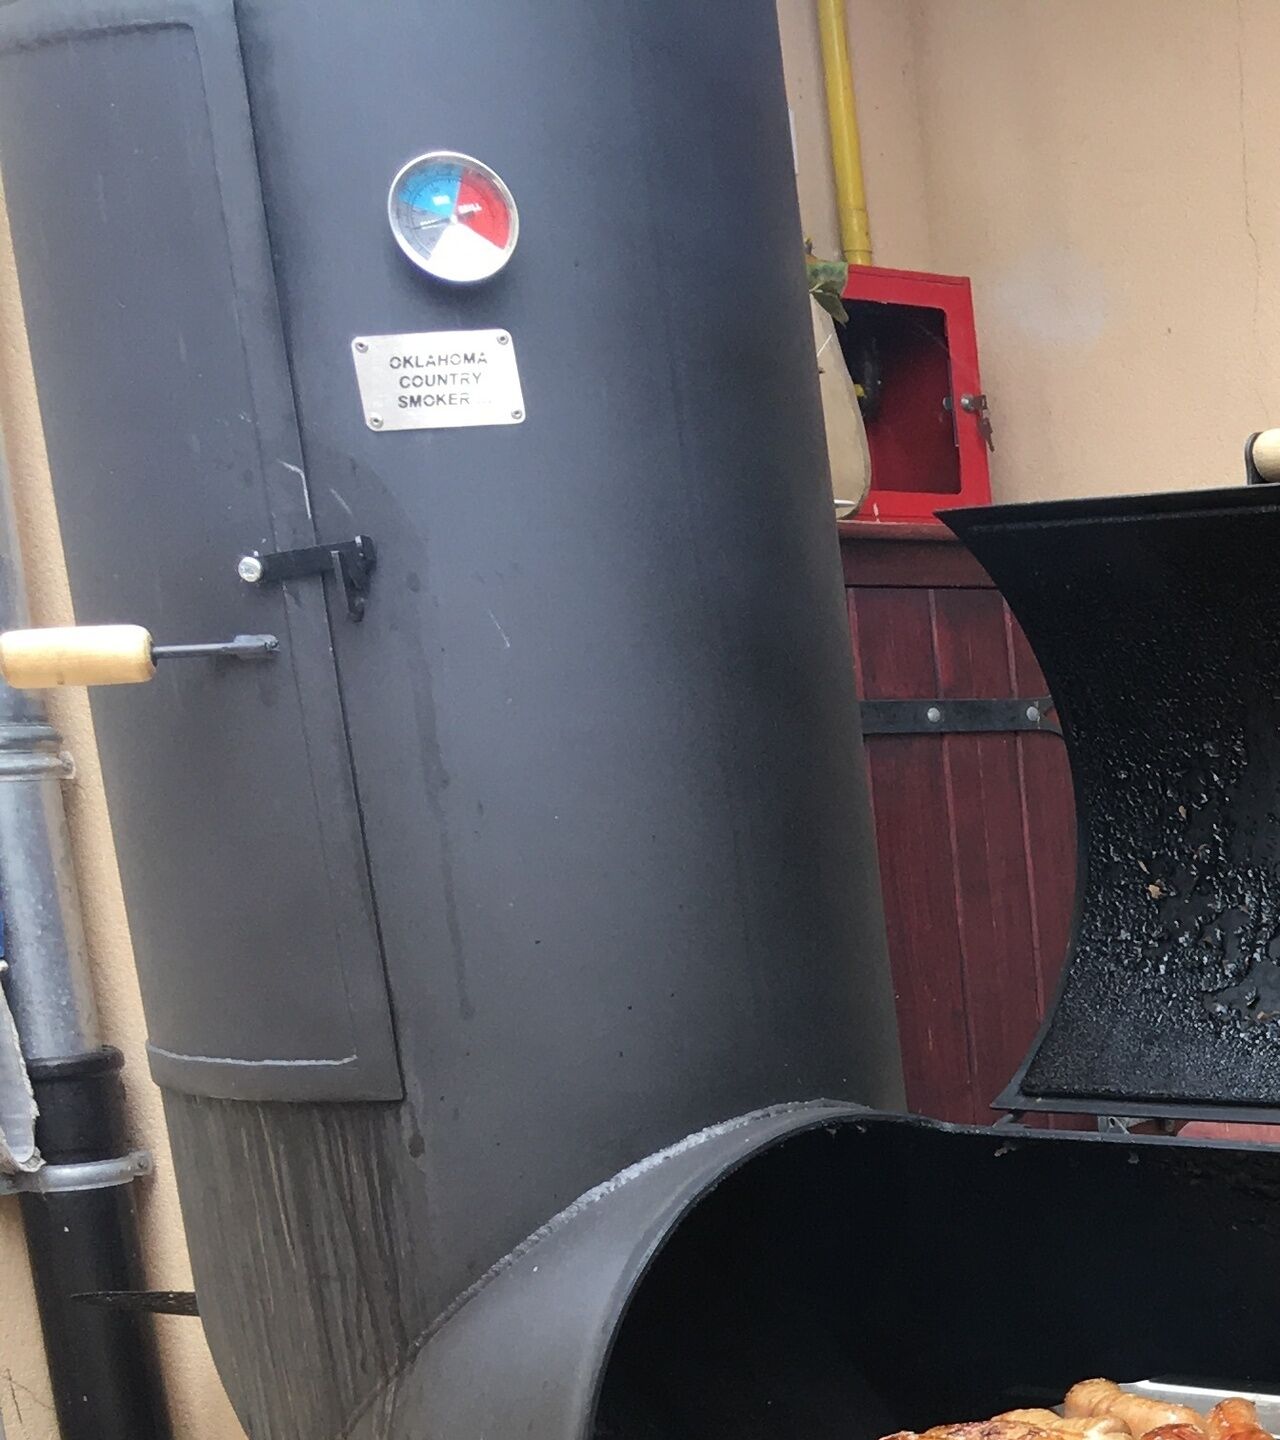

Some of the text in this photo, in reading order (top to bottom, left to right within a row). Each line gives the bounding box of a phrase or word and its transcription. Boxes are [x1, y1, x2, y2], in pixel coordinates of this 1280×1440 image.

[389, 353, 488, 369] OKLAHOMA
[400, 372, 482, 389] COUNTRY
[398, 392, 471, 409] SMOKER
